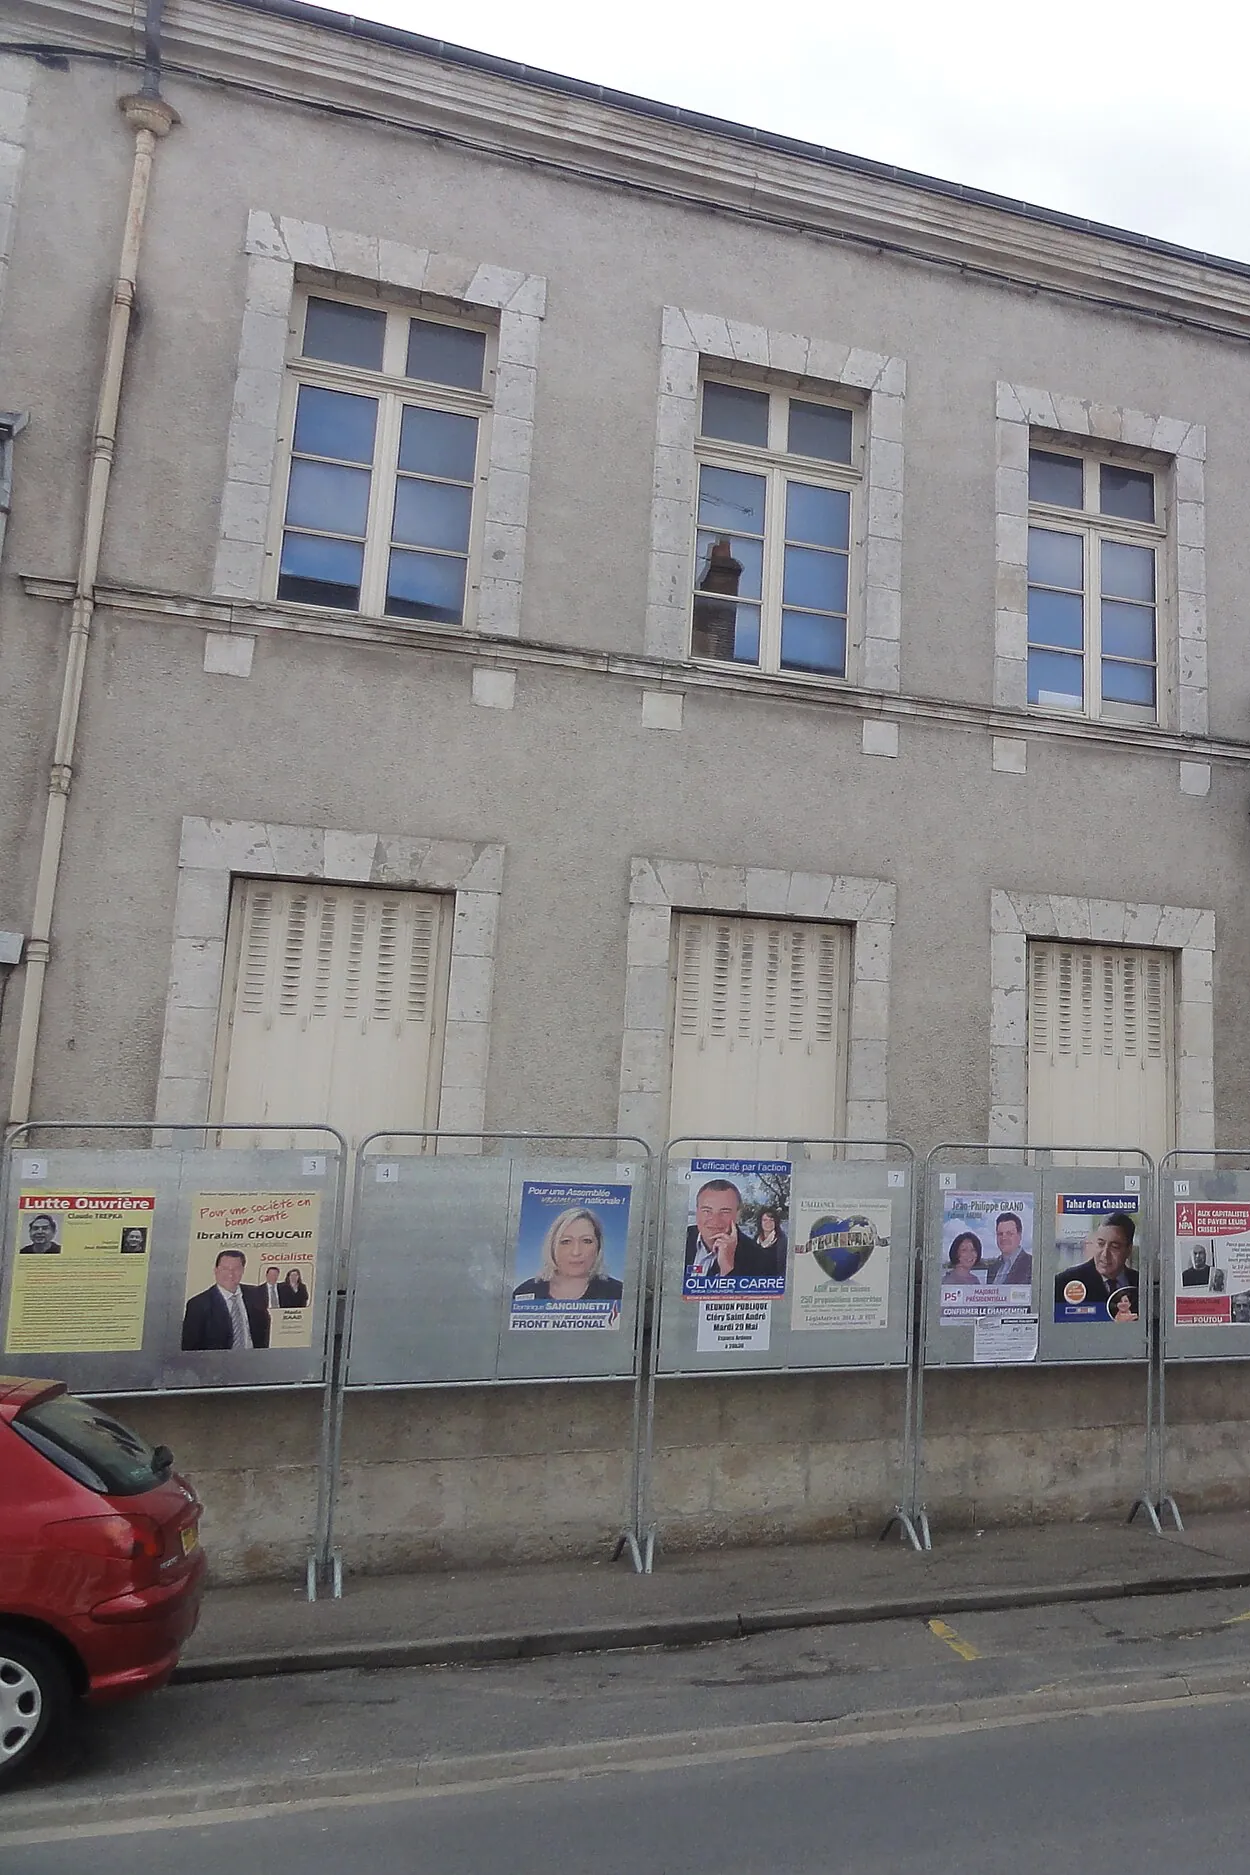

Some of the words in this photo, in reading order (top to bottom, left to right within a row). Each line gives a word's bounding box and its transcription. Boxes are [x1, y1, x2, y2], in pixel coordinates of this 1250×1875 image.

[31, 1163, 39, 1175] 2
[310, 1161, 317, 1171] 3
[696, 1161, 740, 1171] L'efficacité
[742, 1164, 755, 1172] par
[758, 1164, 787, 1172] l'action
[382, 1168, 389, 1178] 4
[624, 1167, 630, 1176] 5
[684, 1172, 692, 1180] 6
[893, 1174, 899, 1183] 7
[944, 1176, 951, 1185] 8
[1130, 1179, 1136, 1187] 9
[528, 1187, 549, 1195] Pour
[1176, 1184, 1187, 1192] 10
[24, 1197, 71, 1209] Lutte
[75, 1197, 150, 1209] Ouvrière
[952, 1200, 999, 1213] Jean-Philippe
[1000, 1201, 1024, 1211] GRAND
[1066, 1199, 1086, 1209] Tahar
[1087, 1200, 1101, 1209] Ben
[1102, 1199, 1136, 1209] Chaabane
[200, 1207, 226, 1219] Pour
[229, 1206, 248, 1215] une
[251, 1199, 295, 1213] société
[297, 1199, 311, 1207] en
[225, 1217, 255, 1227] bonne
[258, 1211, 289, 1223] santé
[1178, 1221, 1193, 1229] NPA
[196, 1231, 244, 1240] Ibrahim
[247, 1230, 313, 1239] CHOUCAIR
[260, 1252, 314, 1261] Socialiste
[686, 1278, 736, 1289] OLIVIER
[739, 1276, 785, 1289] CARRÉ
[944, 1292, 957, 1301] PS
[545, 1302, 610, 1310] SANGUINETTI
[736, 1302, 768, 1310] PUBLIQUE
[745, 1313, 766, 1321] André
[512, 1320, 549, 1328] FRONT
[552, 1320, 606, 1328] NATIONAL
[713, 1323, 734, 1331] Mardi
